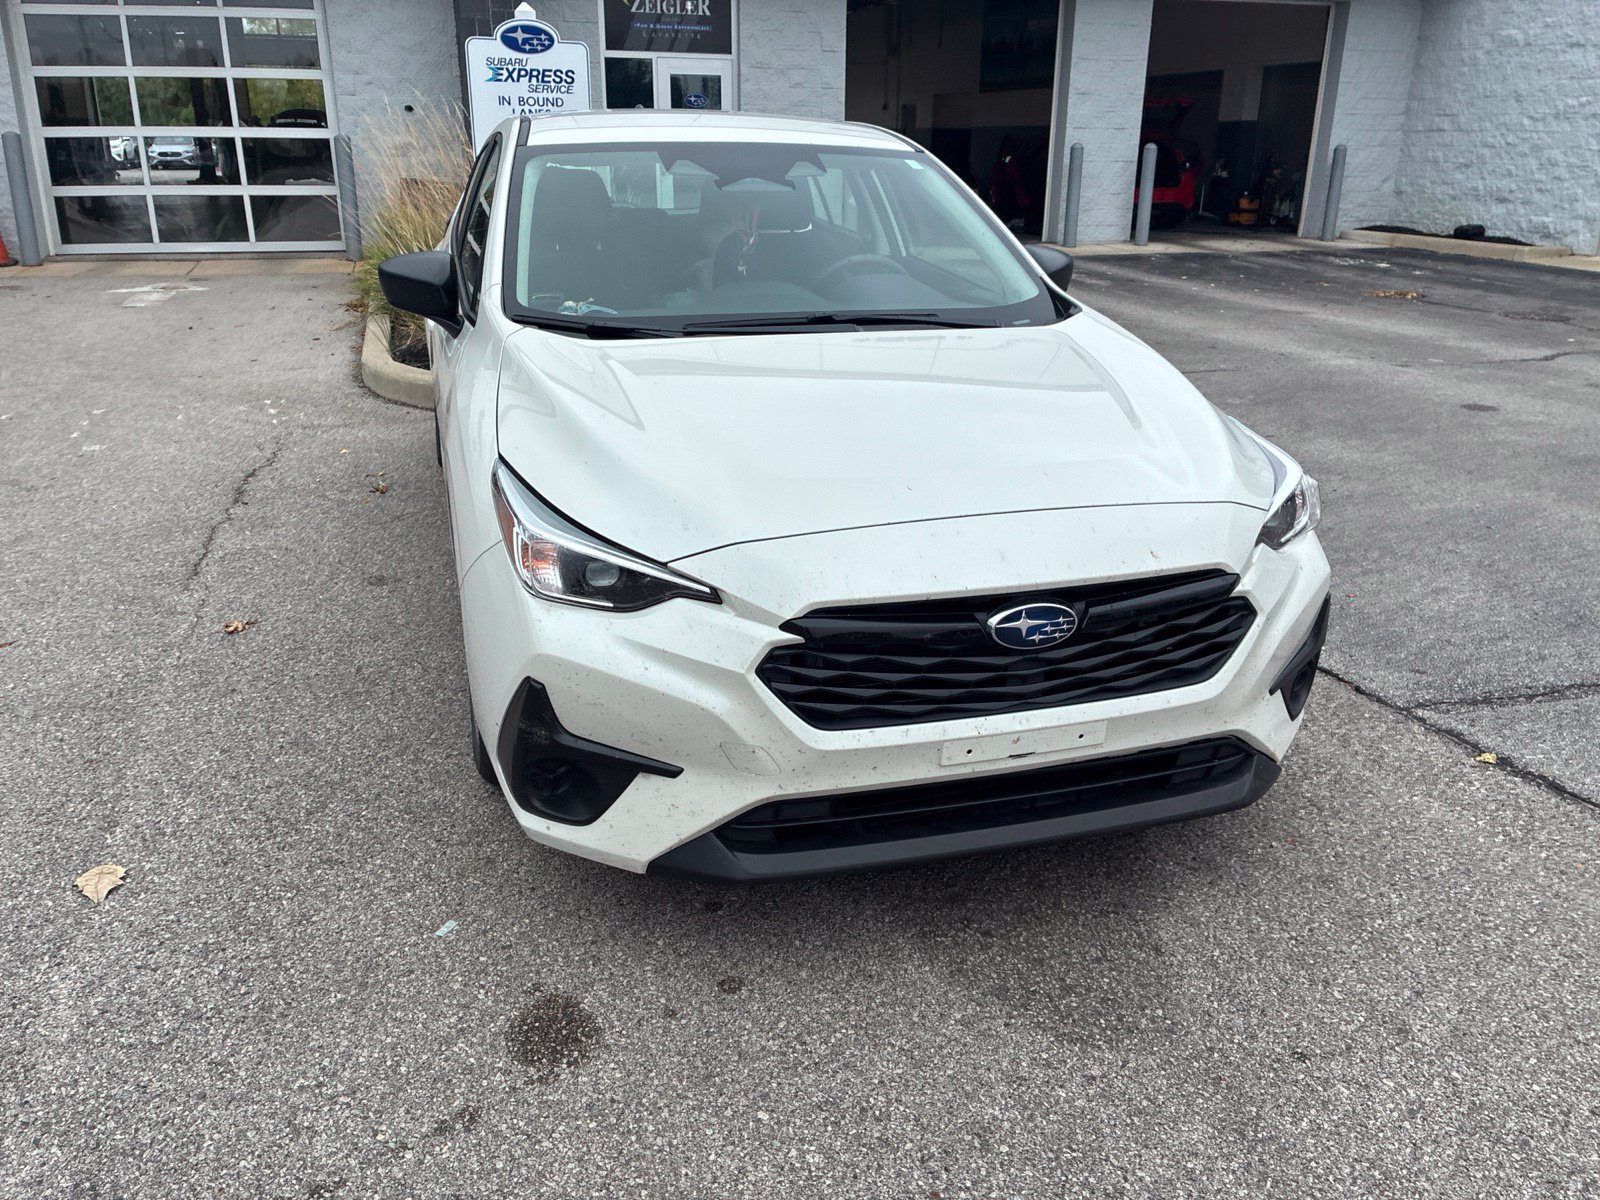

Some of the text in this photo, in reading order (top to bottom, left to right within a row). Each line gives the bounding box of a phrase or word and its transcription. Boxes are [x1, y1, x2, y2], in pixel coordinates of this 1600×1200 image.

[630, 0, 711, 16] ZEIGLER
[485, 56, 529, 67] SUBARU
[485, 66, 576, 85] EXPRESS
[527, 83, 575, 94] SERVICE
[498, 95, 564, 108] IN BOUND
